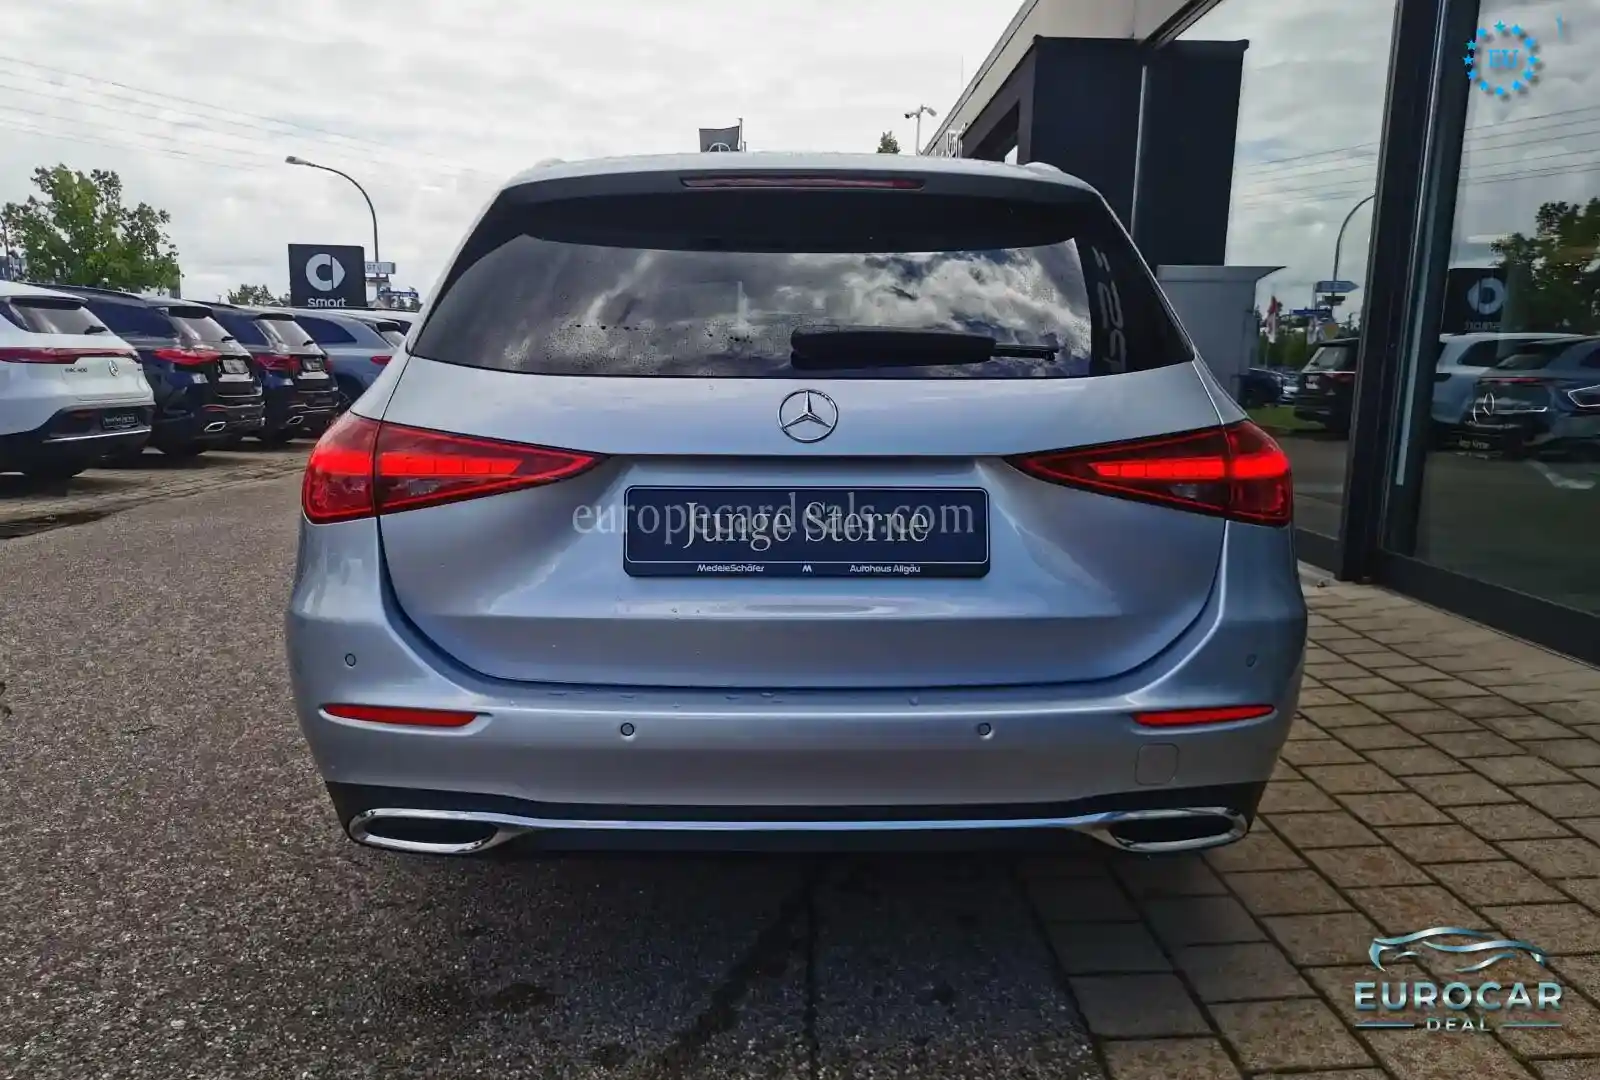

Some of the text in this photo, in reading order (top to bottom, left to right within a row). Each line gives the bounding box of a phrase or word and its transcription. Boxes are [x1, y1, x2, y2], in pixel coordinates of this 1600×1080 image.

[307, 298, 346, 308] smart
[682, 501, 928, 551] Junge Sterne
[849, 564, 921, 575] Autohaus Allgäu
